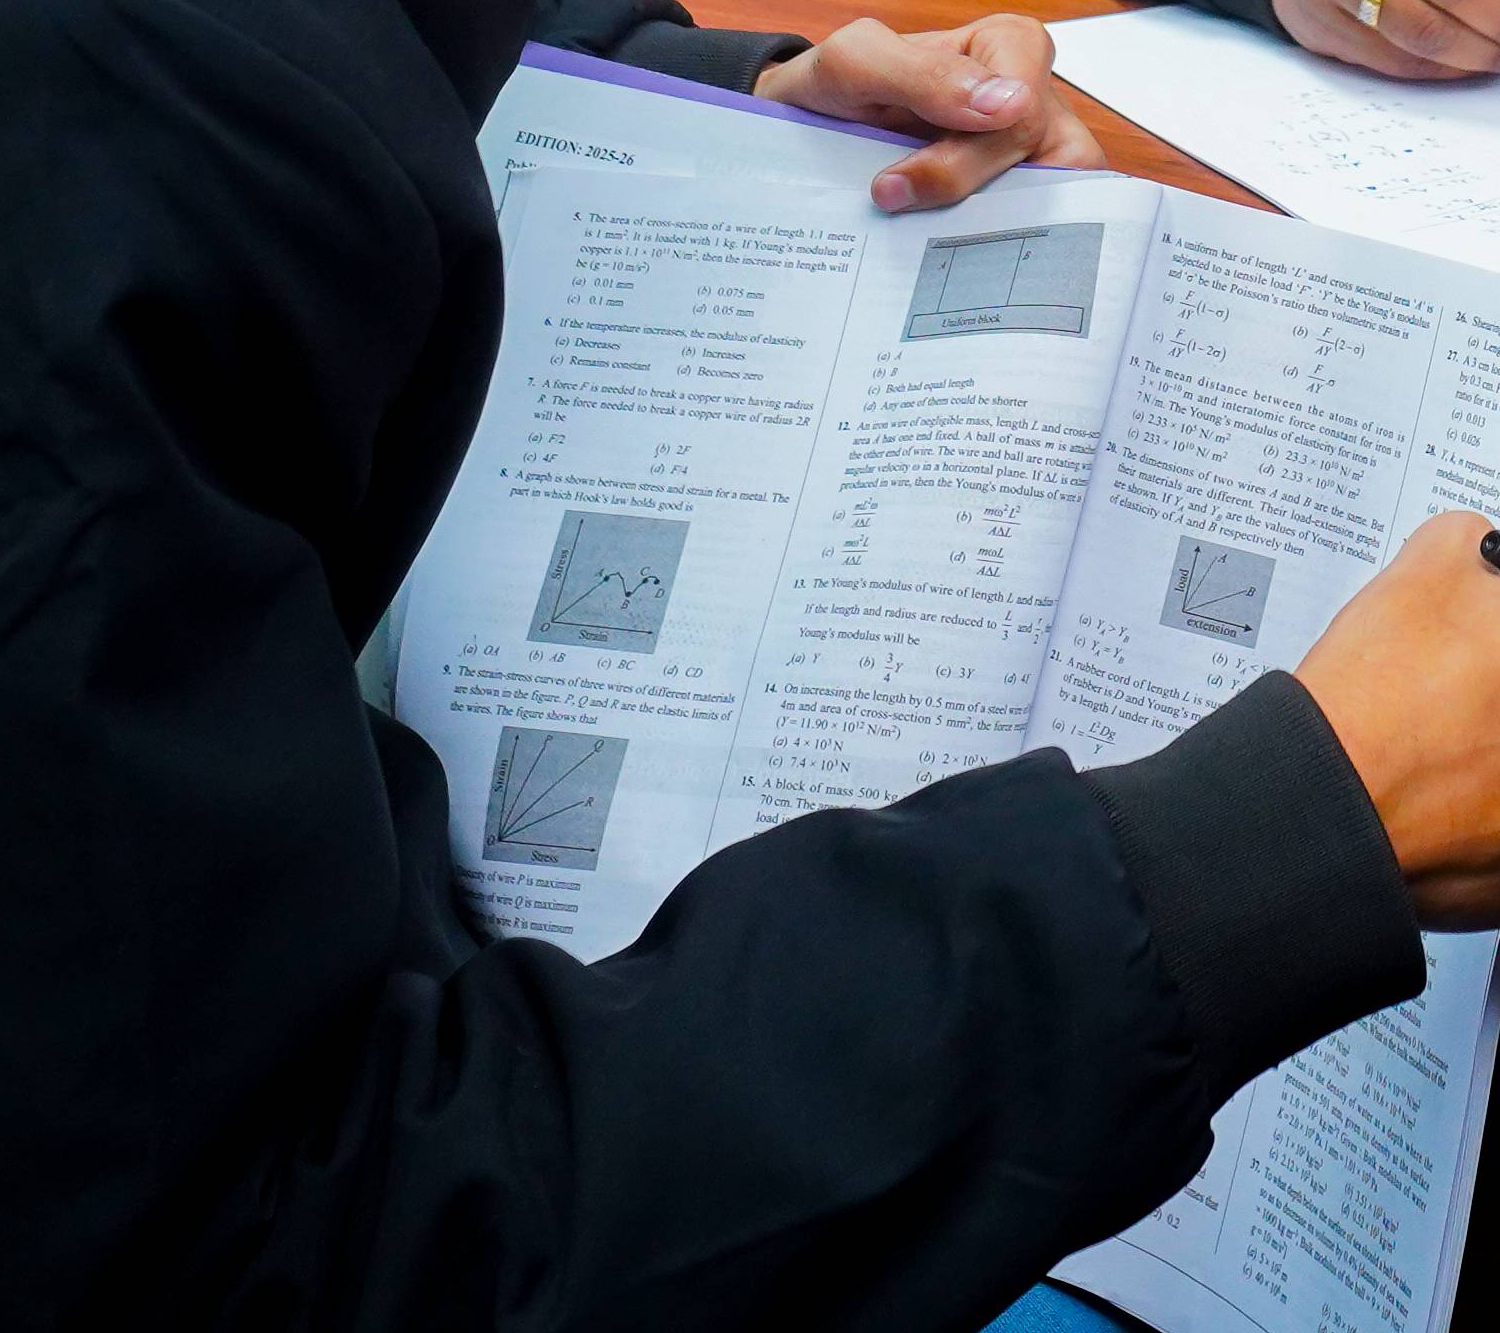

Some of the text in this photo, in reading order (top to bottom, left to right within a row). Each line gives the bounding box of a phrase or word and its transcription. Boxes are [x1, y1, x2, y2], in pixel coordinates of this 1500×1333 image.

[515, 130, 637, 166] EDITION: 2025-26
[588, 212, 607, 223] The
[609, 216, 629, 225] area
[632, 216, 645, 225] of
[645, 217, 708, 230] cross-section
[711, 221, 724, 231] of
[735, 225, 756, 233] wire
[759, 225, 772, 234] of
[773, 225, 804, 240] length
[809, 229, 823, 239] 1.1
[826, 233, 856, 242] metre
[559, 317, 567, 327] If
[566, 317, 584, 329] the
[689, 328, 705, 338] the
[706, 330, 748, 342] modulus
[749, 333, 760, 343] of
[759, 333, 805, 349] elasticity
[574, 335, 621, 350] Decreases
[701, 347, 746, 361] Increases
[1144, 359, 1161, 373] The
[1164, 369, 1192, 383] mean
[1196, 375, 1247, 397] distance
[1252, 389, 1302, 411] between
[1307, 404, 1324, 417] the
[1328, 412, 1358, 427] atoms
[1361, 421, 1374, 432] of
[1375, 426, 1393, 438] iron
[1397, 434, 1404, 442] is
[1122, 446, 1137, 460] The
[1139, 452, 1194, 476] dimensions
[1197, 470, 1212, 481] of
[1213, 474, 1233, 486] two
[1237, 480, 1266, 495] wires
[1268, 488, 1278, 498] A
[1279, 493, 1300, 504] and
[1302, 496, 1312, 507] B
[1313, 502, 1328, 512] are
[1330, 505, 1344, 517] the
[552, 549, 569, 580] Stress
[813, 578, 828, 588] The
[831, 577, 867, 590] Young's
[868, 578, 915, 591] modulus
[914, 581, 928, 592] of
[929, 583, 954, 595] wire
[955, 586, 970, 597] of
[970, 587, 1004, 603] length
[1006, 592, 1013, 603] L
[1015, 594, 1037, 606] and
[1174, 568, 1189, 592] load
[1186, 618, 1237, 638] extension
[764, 682, 777, 693] 14.
[784, 682, 798, 694] On
[799, 683, 851, 700] increasing
[853, 687, 870, 699] the
[871, 689, 906, 705] length
[907, 693, 922, 708] by
[924, 695, 942, 708] 0.5
[944, 701, 965, 711] mm
[966, 701, 980, 713] of
[987, 703, 1012, 714] steel
